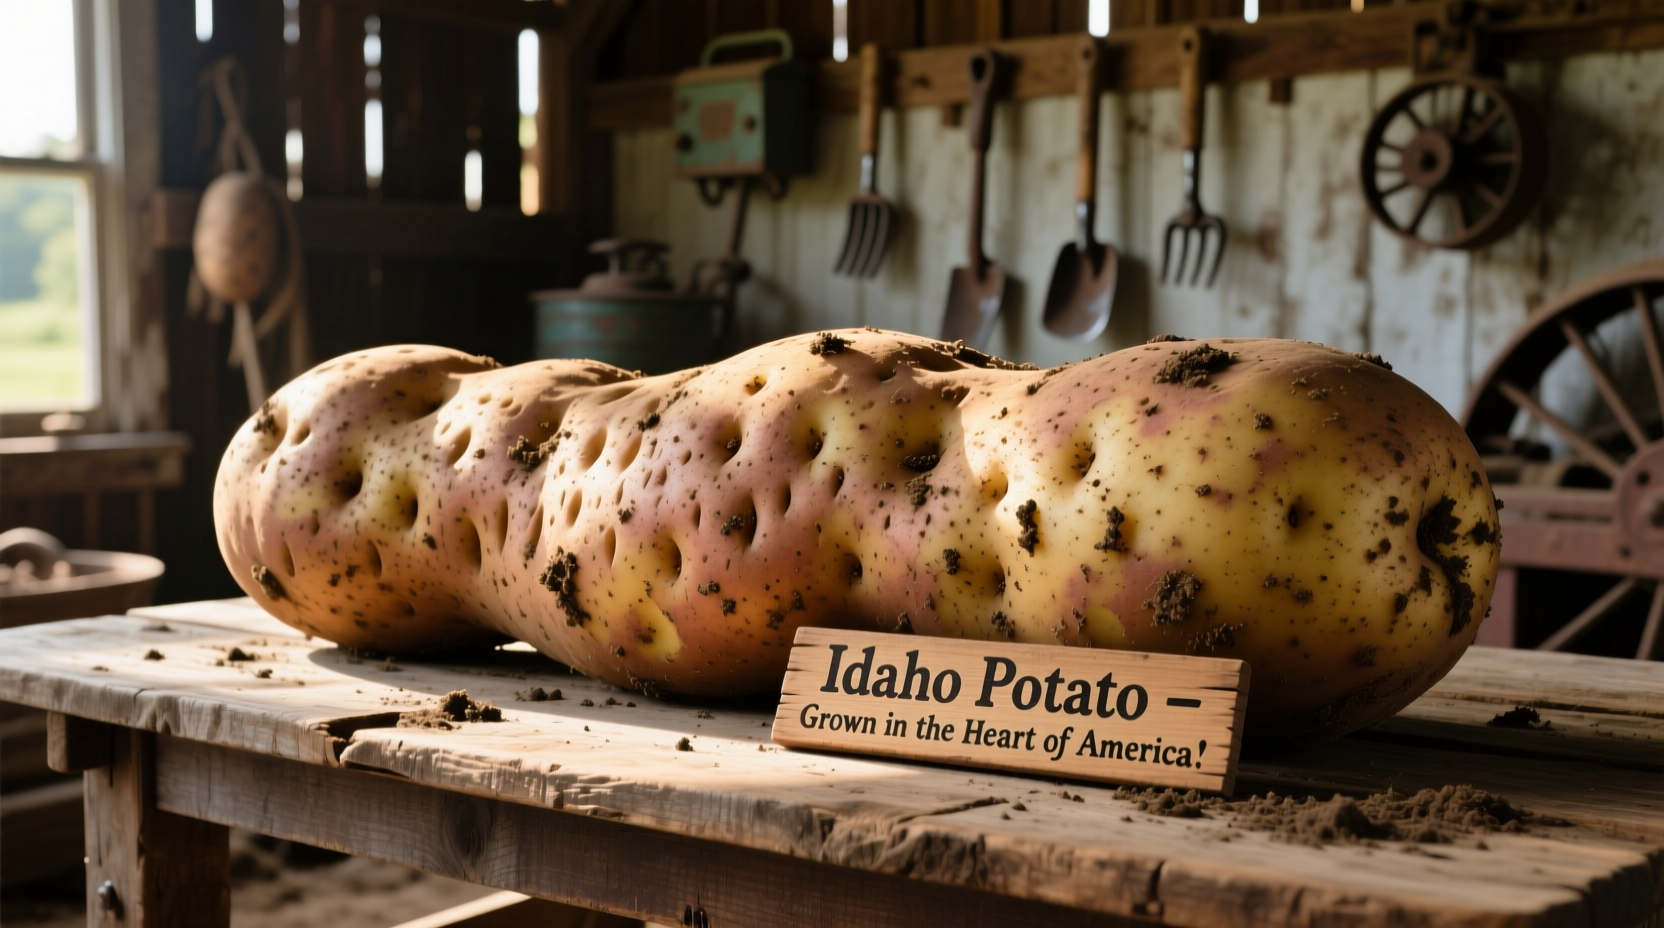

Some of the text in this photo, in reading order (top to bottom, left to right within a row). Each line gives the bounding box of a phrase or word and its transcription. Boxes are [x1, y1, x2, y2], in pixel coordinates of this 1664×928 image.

[820, 643, 962, 704] Idaho
[974, 655, 1149, 721] Potato
[799, 703, 1207, 769] Grown in the Heart of America!
